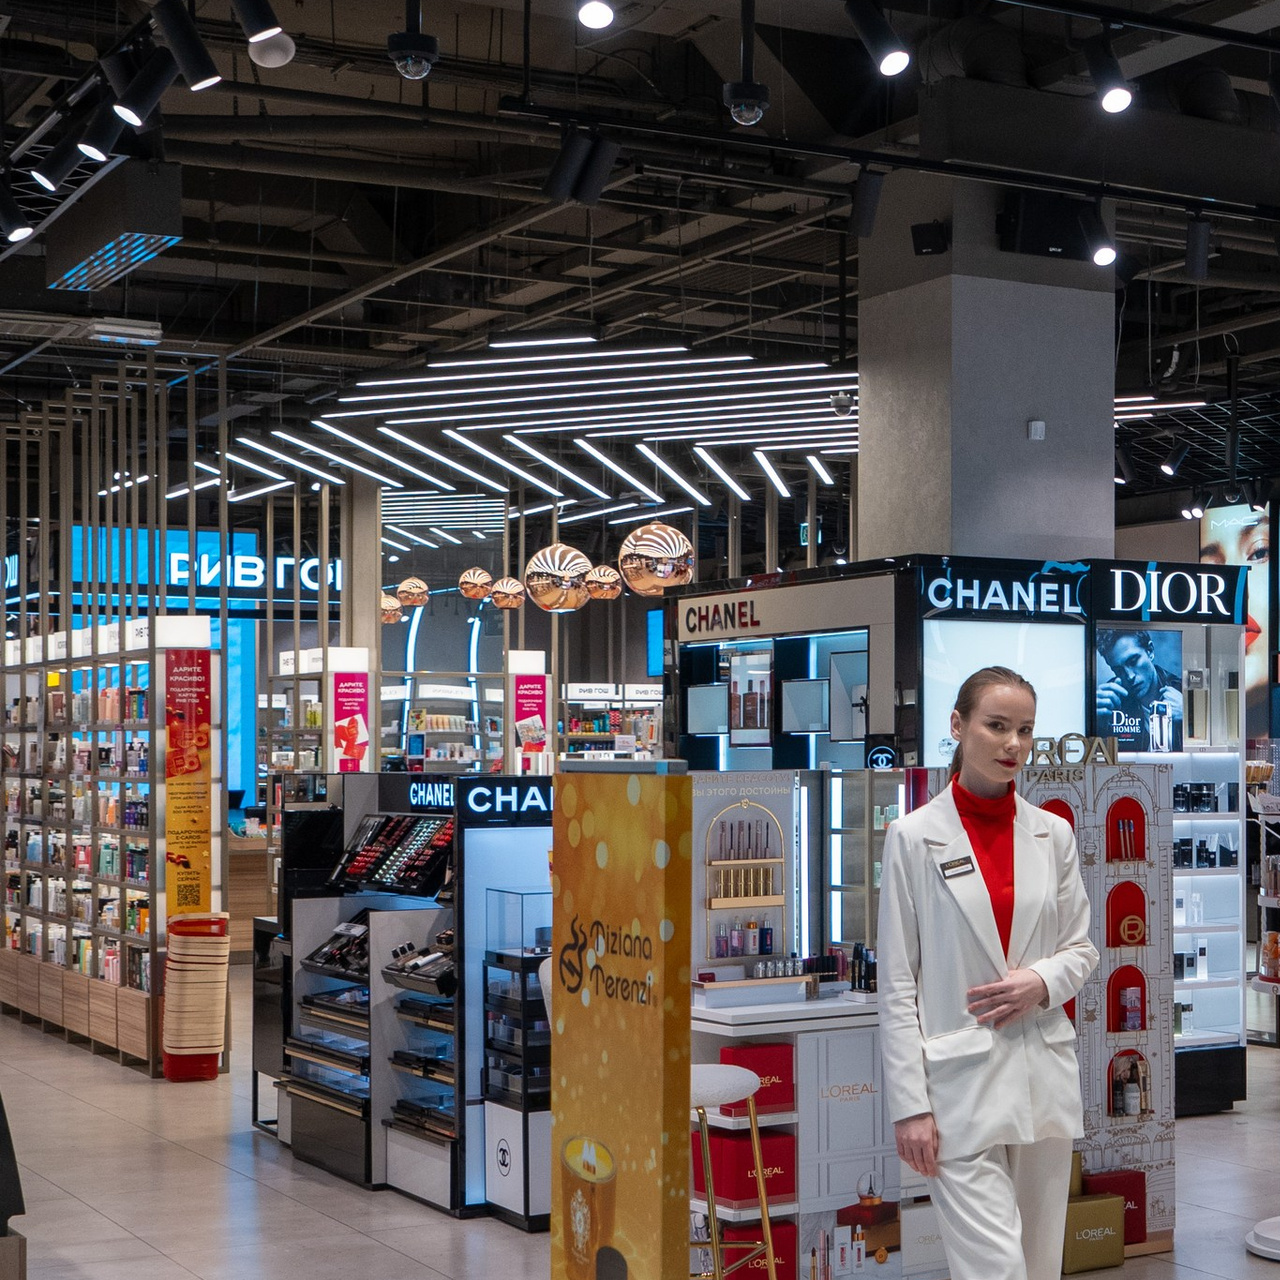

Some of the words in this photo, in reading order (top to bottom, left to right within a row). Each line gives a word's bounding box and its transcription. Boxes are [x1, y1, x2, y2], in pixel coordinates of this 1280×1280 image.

[276, 557, 342, 591] ГО
[928, 578, 1081, 613] CHANEL
[1110, 569, 1230, 615] DIOR
[685, 600, 760, 633] CHANEL
[1112, 710, 1141, 726] Dior
[707, 787, 736, 796] ЭТОГО
[739, 786, 790, 796] ДОСТОЙНЫ
[1026, 770, 1084, 782] PARIS
[410, 783, 454, 807] CHANEL
[468, 786, 553, 812] CHA
[589, 920, 652, 960] Tiziana
[589, 965, 651, 1006] Terenzi
